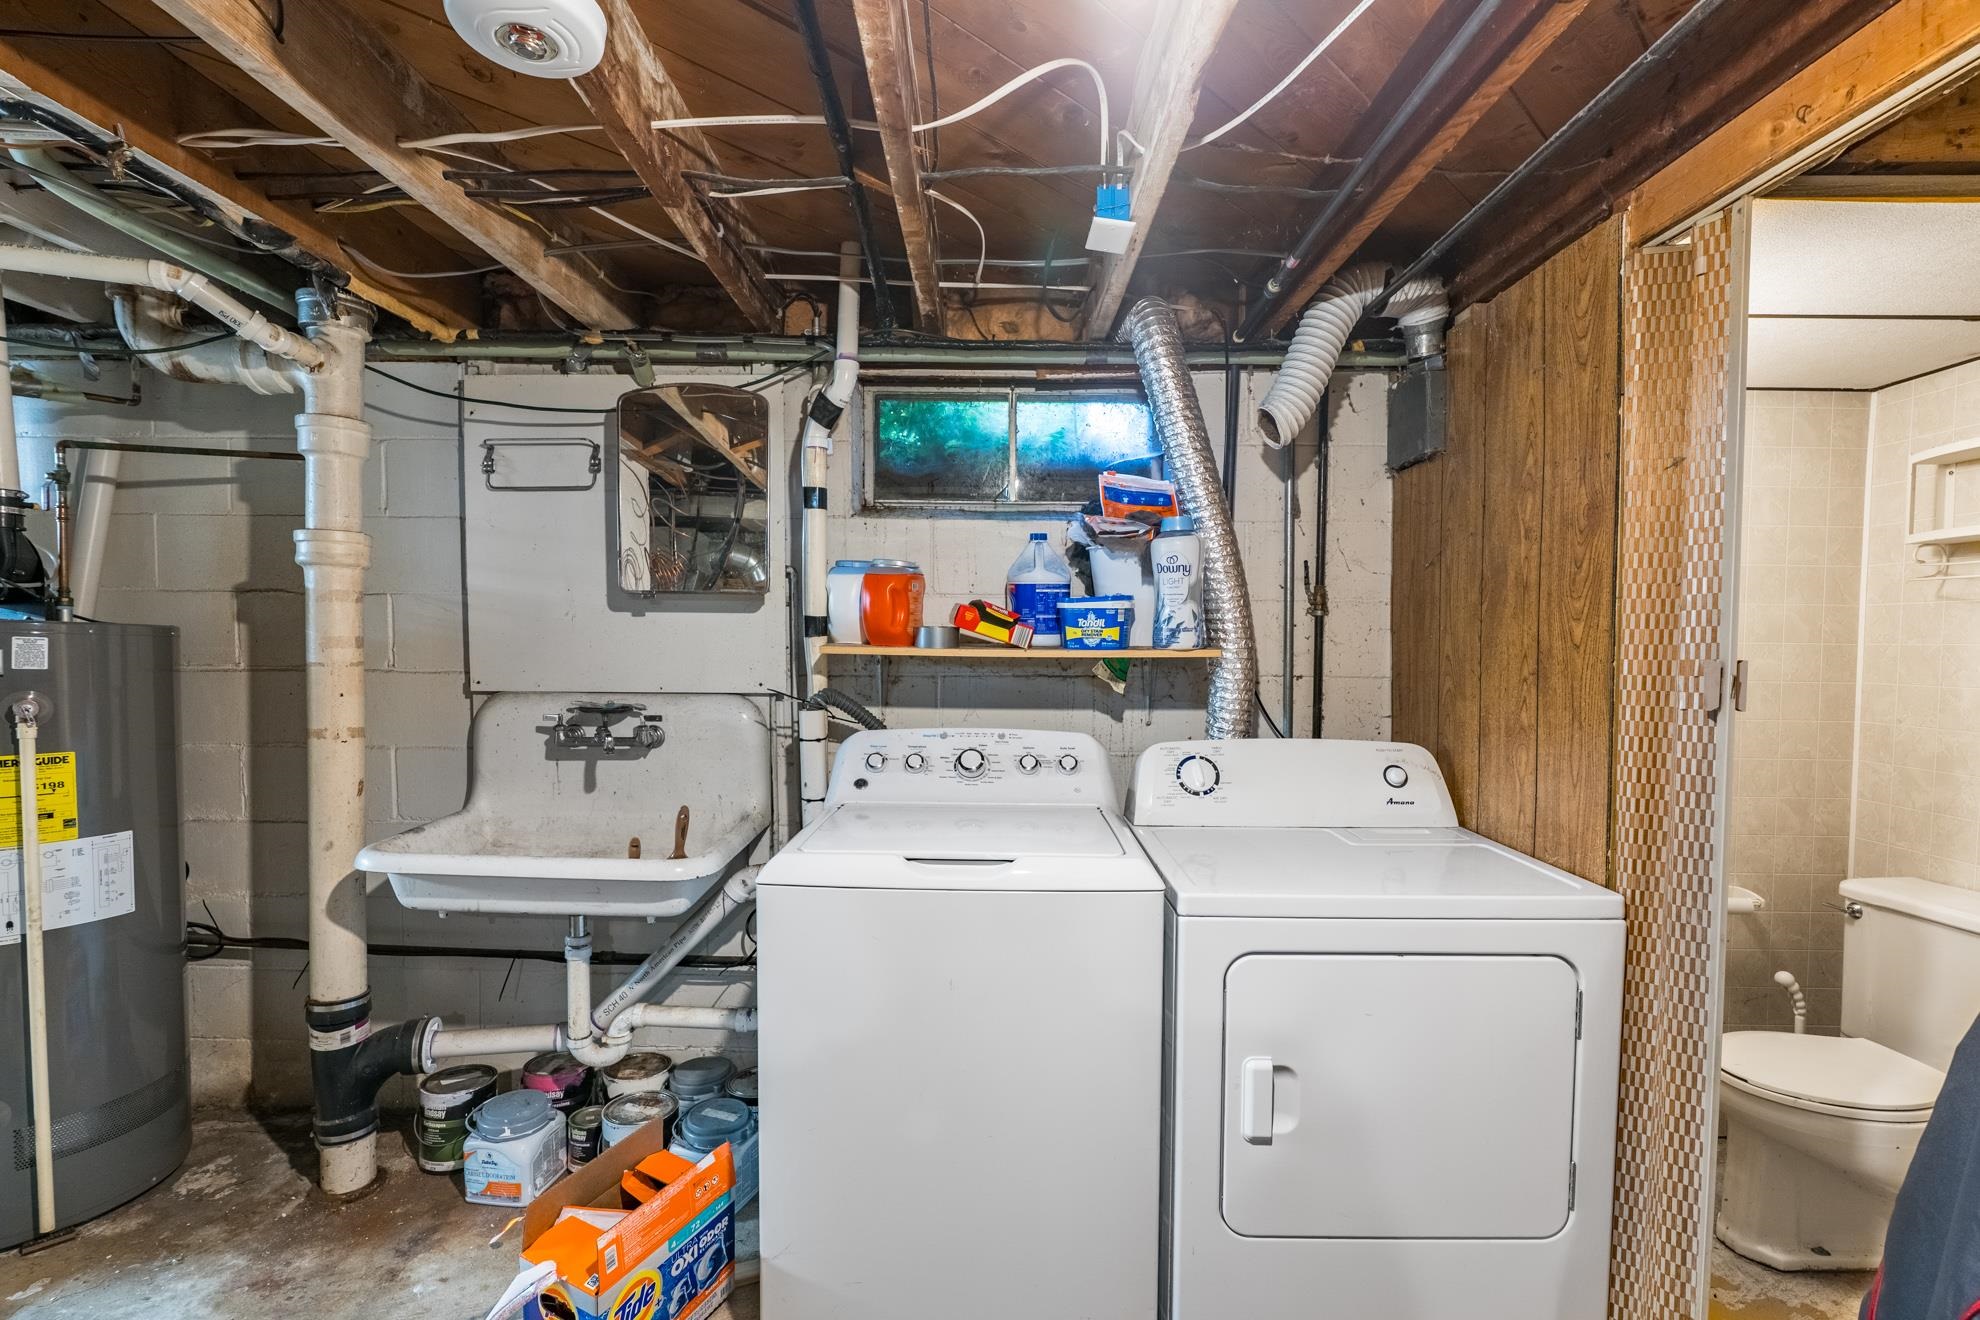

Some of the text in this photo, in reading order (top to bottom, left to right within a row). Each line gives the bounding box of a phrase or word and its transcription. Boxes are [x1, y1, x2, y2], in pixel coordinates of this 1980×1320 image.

[1156, 562, 1192, 577] Downy
[1162, 577, 1185, 586] LIGHT
[1077, 617, 1106, 628] Tandil
[35, 755, 70, 766] GUIDE
[36, 781, 65, 790] 198
[1386, 797, 1415, 805] Amana
[634, 968, 651, 985] North
[650, 947, 675, 971] American
[673, 935, 687, 949] Pipe
[602, 991, 629, 1017] SCH 40
[670, 1240, 677, 1249] 4
[691, 1220, 701, 1233] 72
[699, 1215, 729, 1248] ODOR
[670, 1243, 699, 1277] OXI
[671, 1236, 699, 1264] ULTRA
[614, 1281, 657, 1320] Tide
